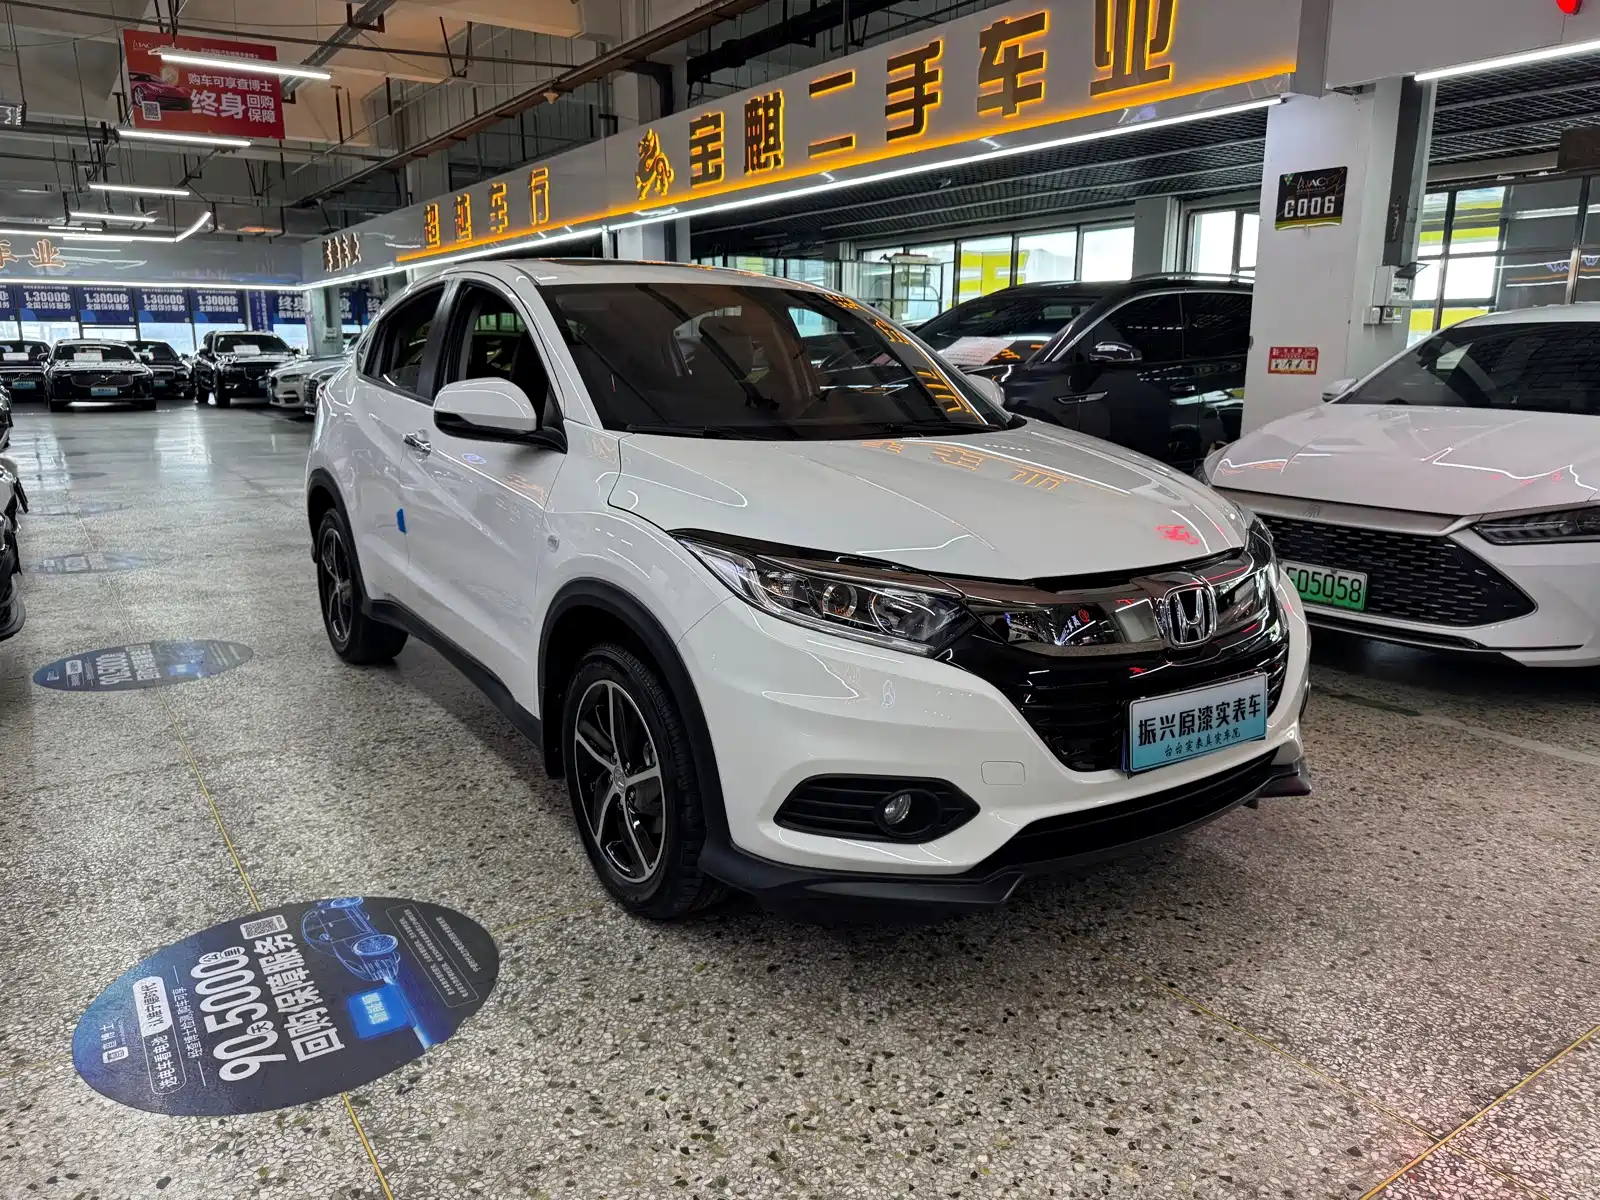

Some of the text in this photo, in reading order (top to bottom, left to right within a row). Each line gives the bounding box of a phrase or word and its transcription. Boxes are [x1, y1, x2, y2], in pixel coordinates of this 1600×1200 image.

[187, 72, 273, 93] 购车可享查博士
[190, 89, 247, 119] 终身
[246, 94, 275, 109] 回购
[249, 109, 277, 123] 保障
[1284, 196, 1336, 217] C006
[1138, 694, 1261, 747] 振兴原漆实表车
[140, 982, 165, 1028] 认准宁德时代
[253, 933, 346, 1062] 回购保障服务
